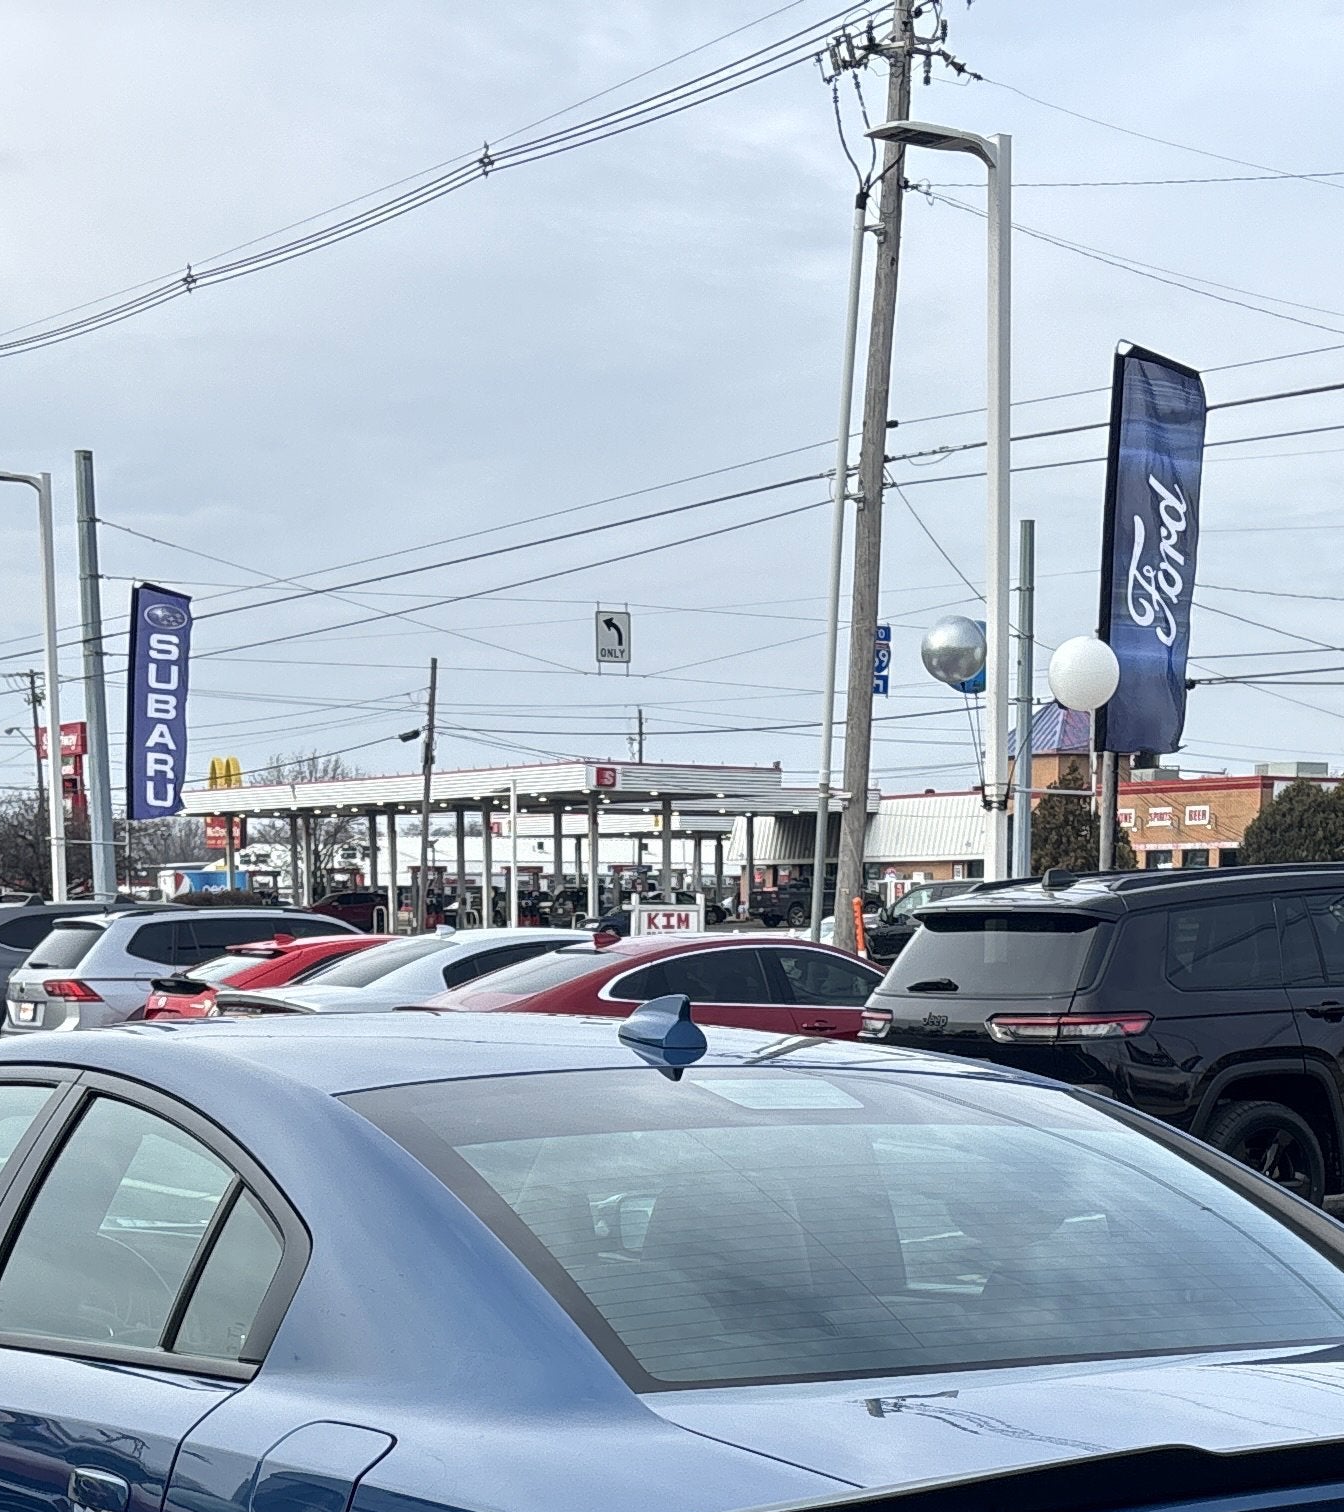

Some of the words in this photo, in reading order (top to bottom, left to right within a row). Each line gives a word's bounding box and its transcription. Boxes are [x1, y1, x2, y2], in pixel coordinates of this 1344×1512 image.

[1127, 474, 1188, 647] Ford
[600, 647, 626, 659] ONLY
[145, 633, 180, 808] SUBARU
[1188, 809, 1207, 821] BEER
[646, 912, 690, 930] KIM
[922, 1011, 949, 1031] Jeep
